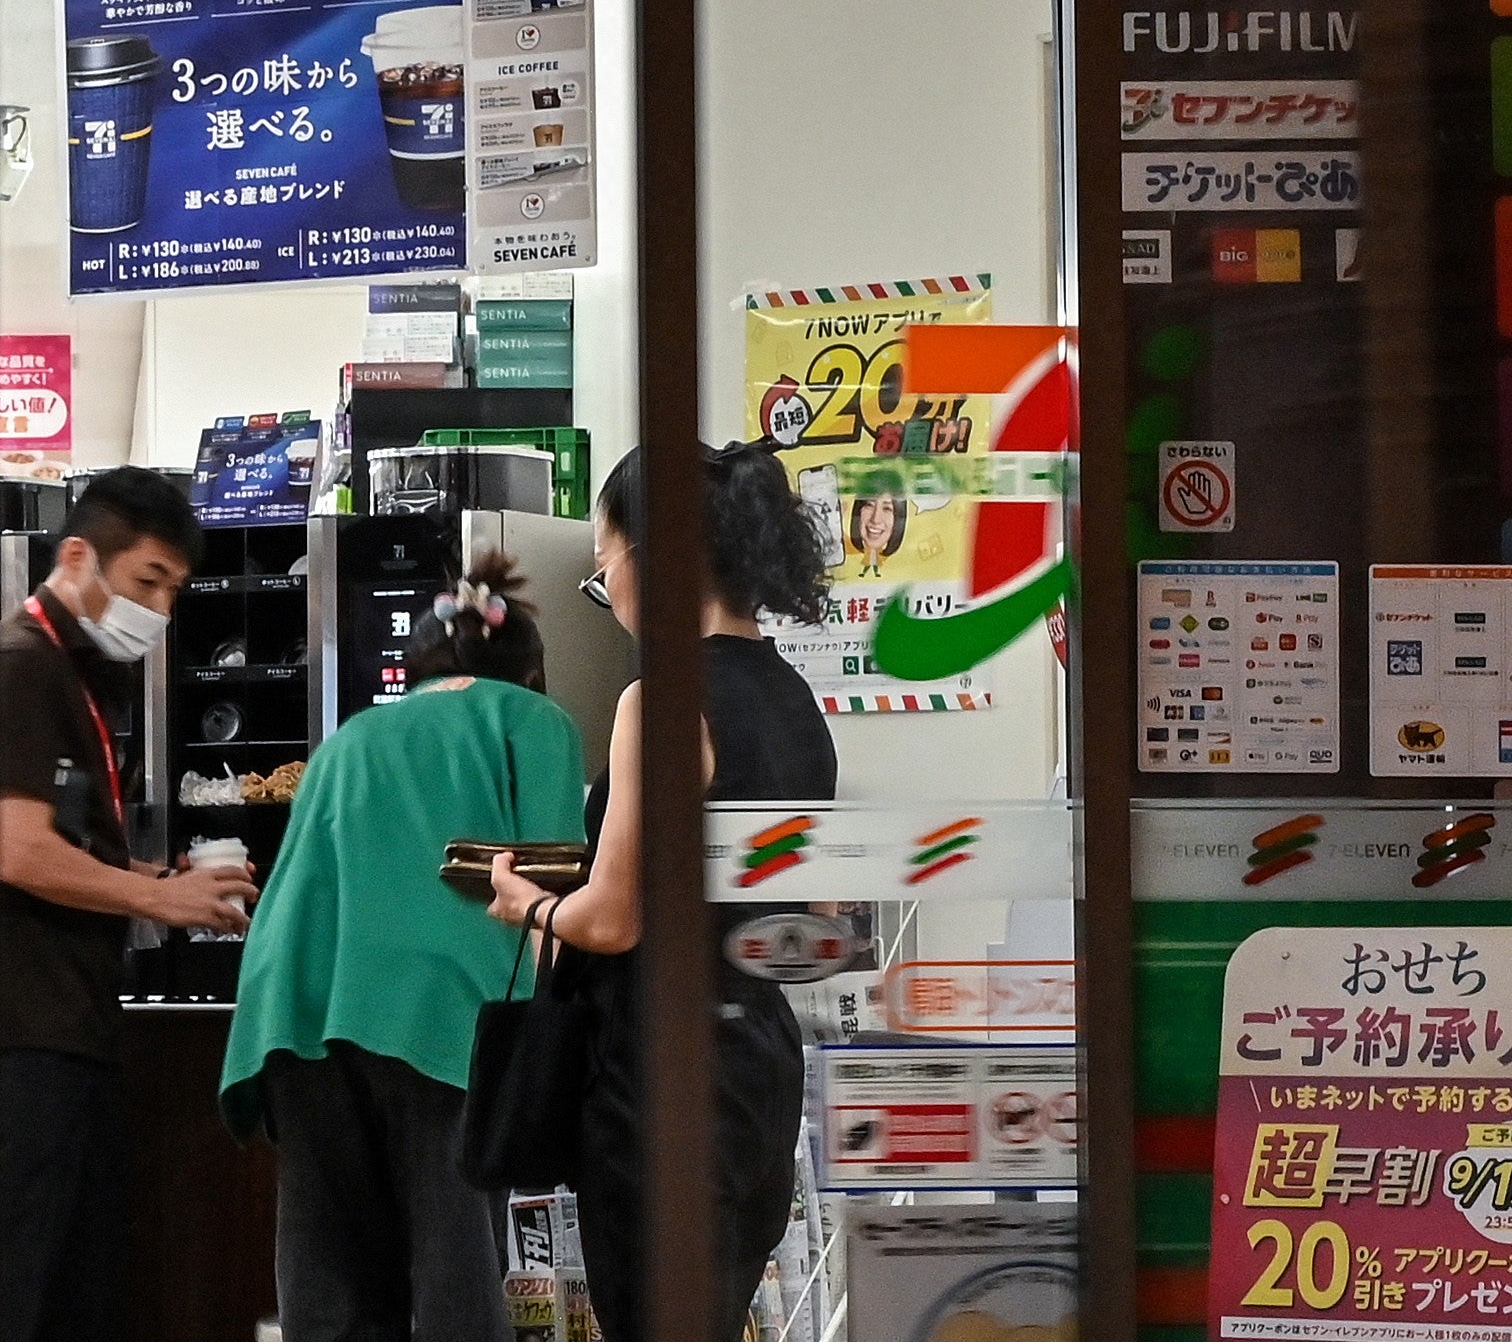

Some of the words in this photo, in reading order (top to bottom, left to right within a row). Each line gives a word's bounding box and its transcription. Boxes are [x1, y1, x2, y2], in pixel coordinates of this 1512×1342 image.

[498, 65, 515, 76] ICE
[518, 61, 560, 73] COFFEE
[172, 53, 360, 102] 3つの味から
[206, 108, 334, 152] 選べる。
[236, 167, 269, 180] SEVEN
[184, 180, 345, 209] 選べる産地ブレンド
[278, 246, 294, 257] ICE
[494, 248, 538, 263] SEVEN
[82, 260, 105, 271] HOT
[372, 293, 419, 304] SENTIA
[480, 310, 527, 321] SENTIA
[484, 339, 530, 350] SENTIA
[356, 370, 402, 381] SENTIA
[484, 368, 530, 379] SENTIA
[773, 406, 805, 433] 最短
[1166, 444, 1228, 459] さわらない
[1341, 941, 1488, 997] おせち
[1254, 1129, 1442, 1208] 超早割
[1240, 1218, 1350, 1310] 20
[1354, 1279, 1406, 1311] 引き
